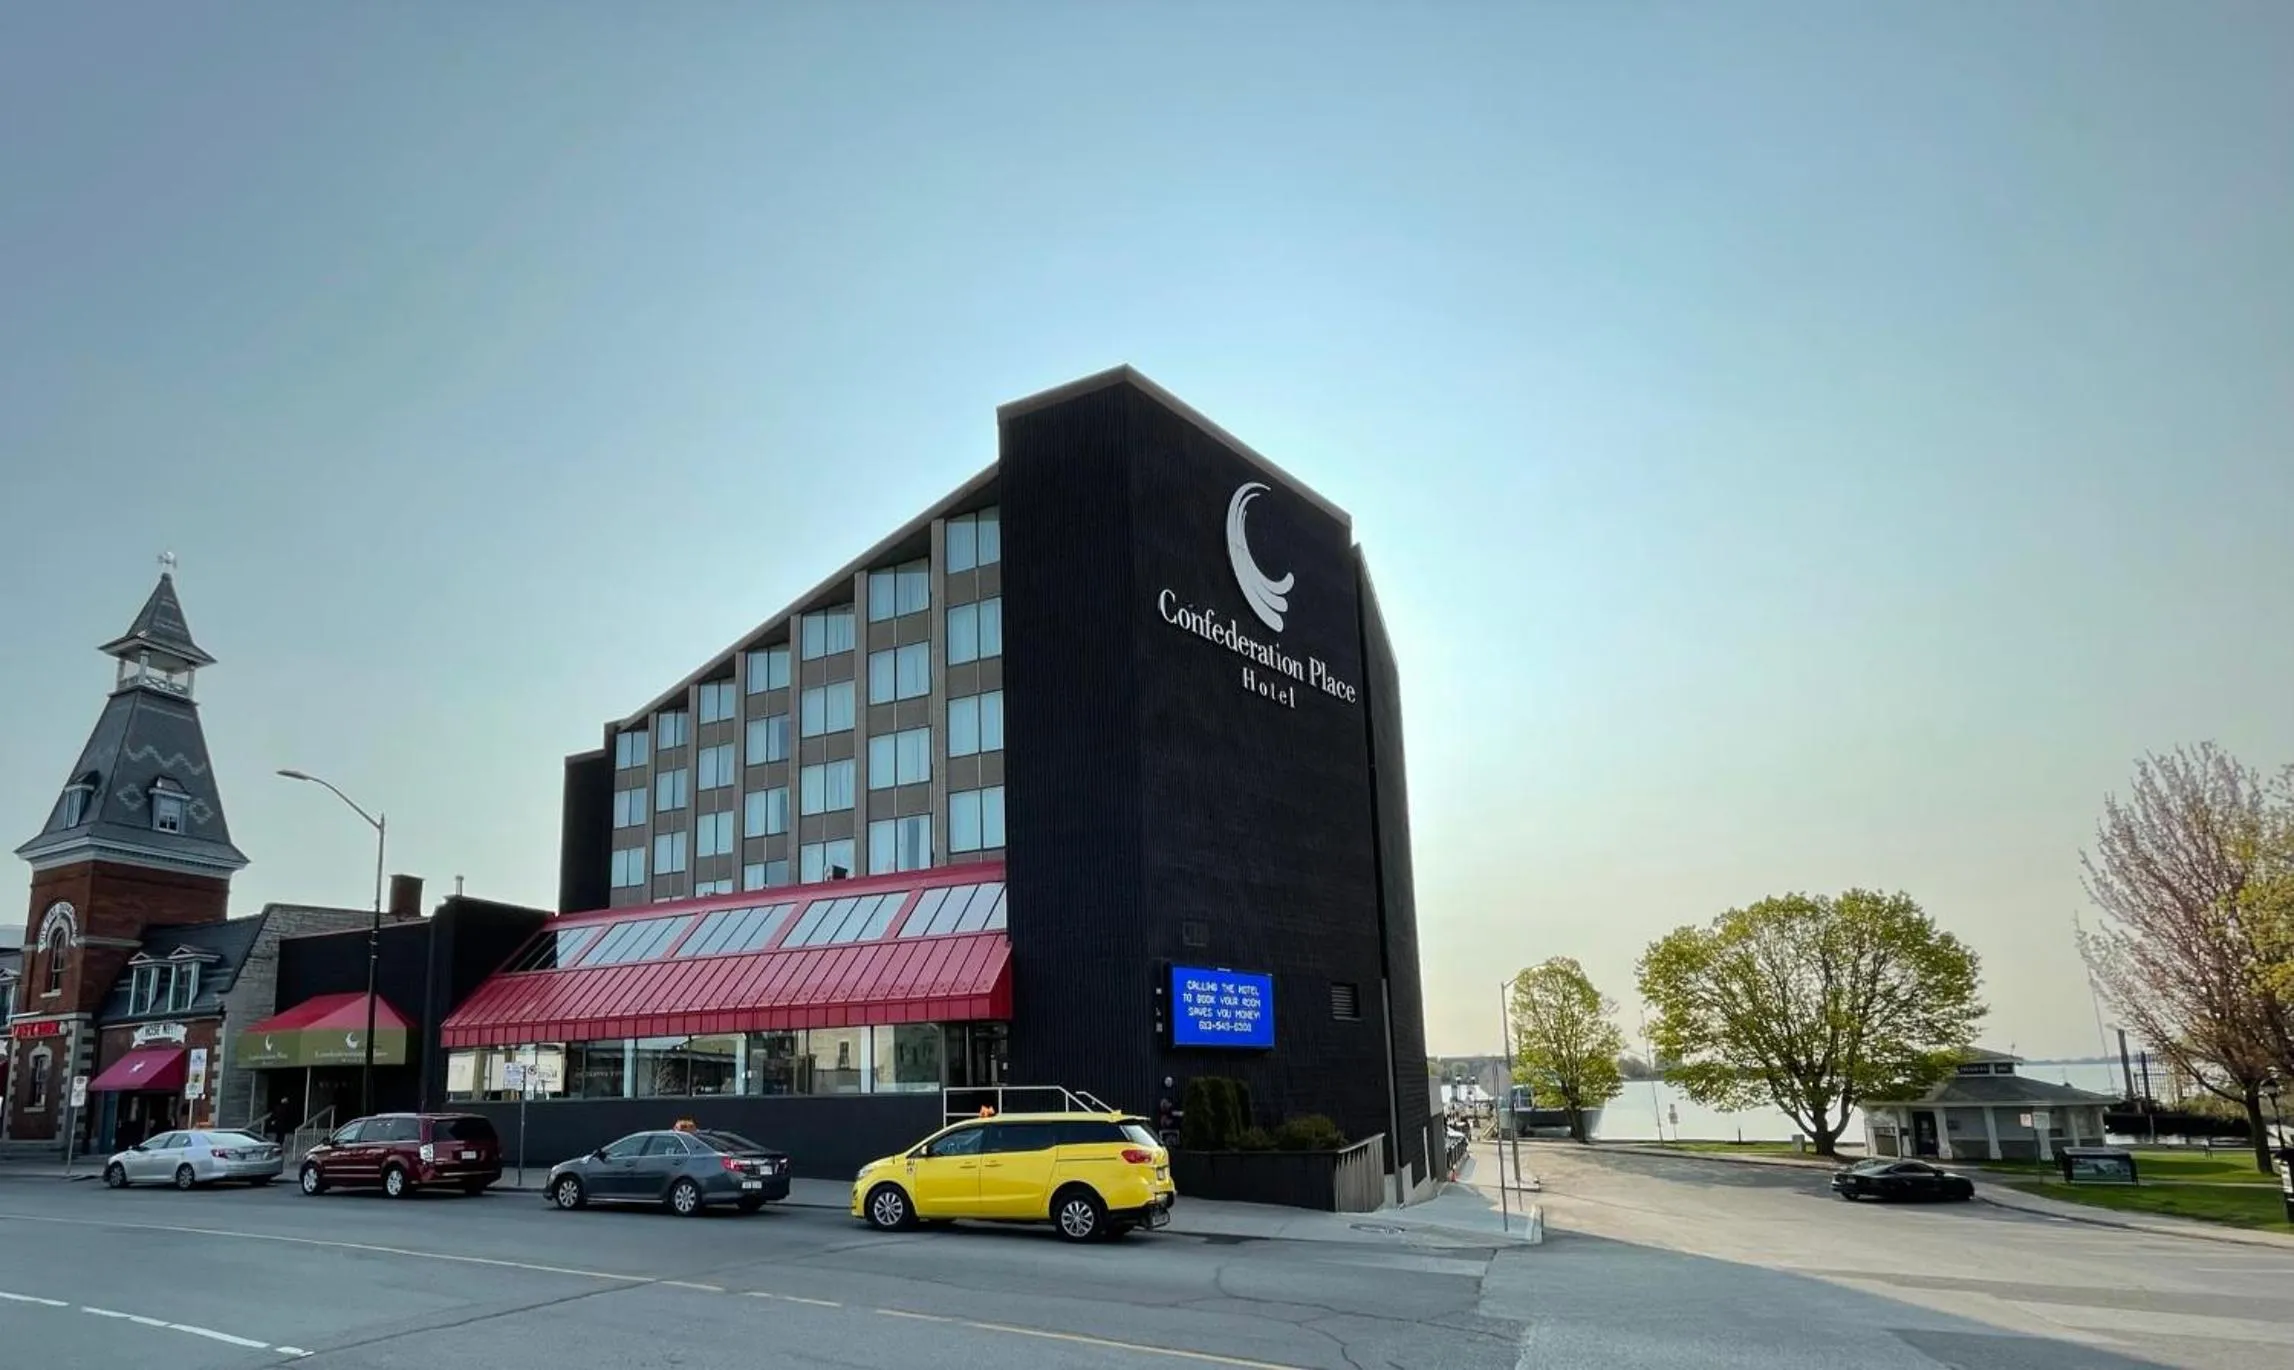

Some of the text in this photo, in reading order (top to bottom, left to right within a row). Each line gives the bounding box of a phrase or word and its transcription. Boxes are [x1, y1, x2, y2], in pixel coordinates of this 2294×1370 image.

[1158, 589, 1356, 704] Confederation Place
[1242, 667, 1296, 708] Hotel
[1187, 980, 1260, 997] CALLING THE HOTEL
[1183, 993, 1261, 1008] TO BOOK YOUR ROOM
[1188, 1007, 1213, 1017] SAVES
[1216, 1008, 1232, 1019] YOU
